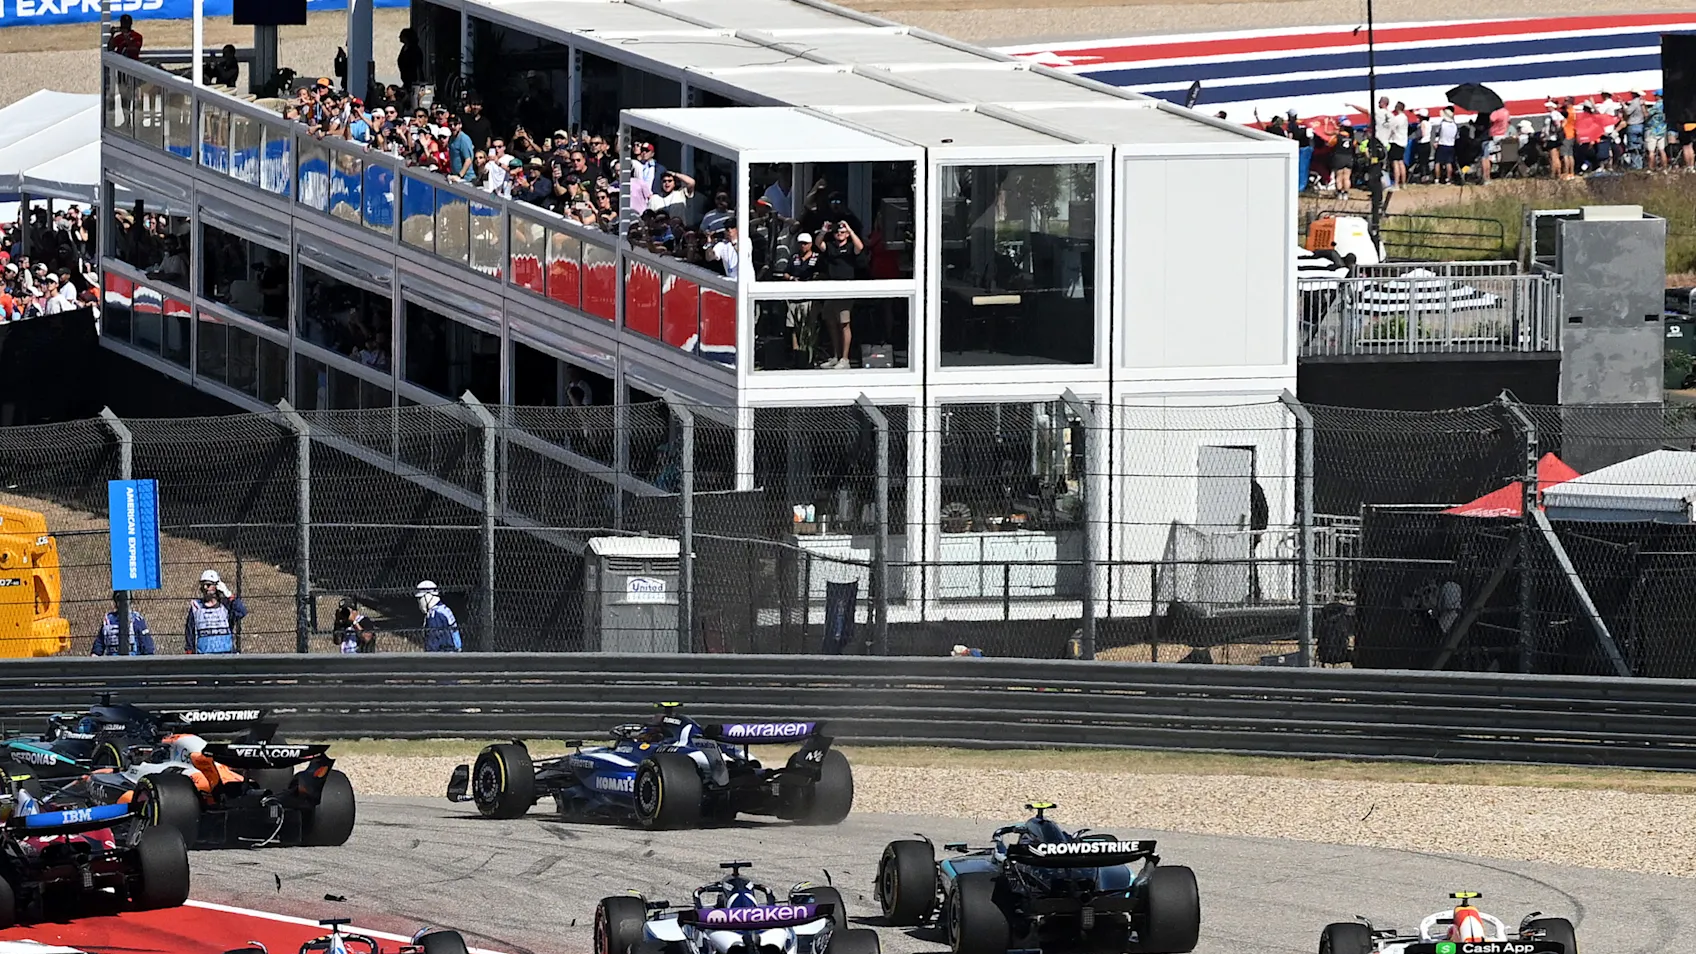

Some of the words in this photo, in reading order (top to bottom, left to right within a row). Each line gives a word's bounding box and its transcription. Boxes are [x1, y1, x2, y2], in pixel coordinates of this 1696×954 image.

[125, 487, 136, 535] AMERICAN
[127, 537, 138, 580] EXPRESS
[632, 583, 664, 593] United
[185, 710, 261, 722] CROWDSTRIKE
[745, 723, 807, 737] kraken
[10, 750, 58, 767] PETRONAS
[596, 776, 635, 793] KOMATS
[61, 808, 92, 824] IBM
[1037, 841, 1140, 855] CROWDSTRIKE
[729, 905, 808, 923] kraken
[1462, 943, 1501, 954] Cash
[1503, 942, 1535, 954] App
